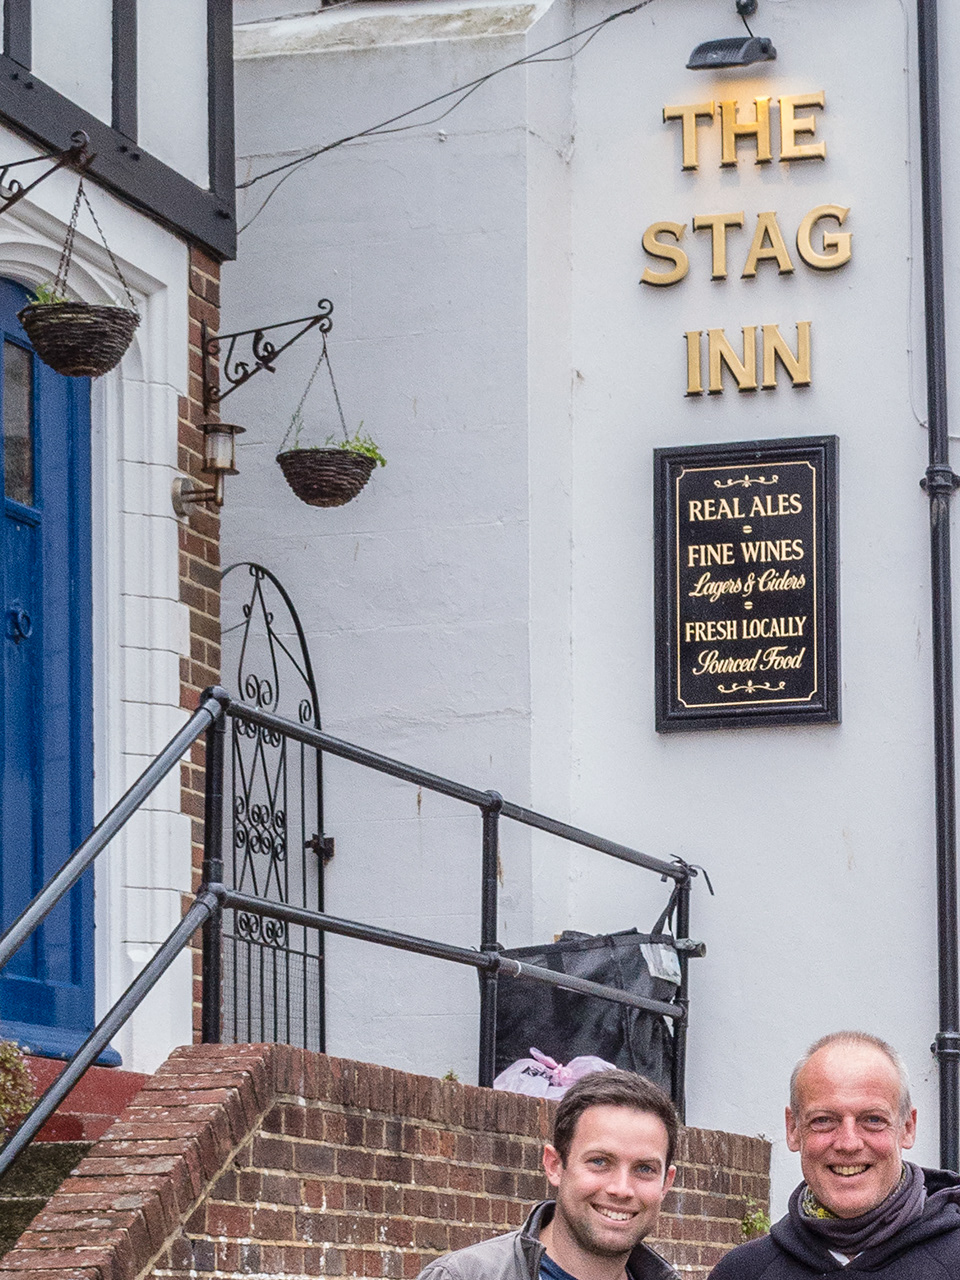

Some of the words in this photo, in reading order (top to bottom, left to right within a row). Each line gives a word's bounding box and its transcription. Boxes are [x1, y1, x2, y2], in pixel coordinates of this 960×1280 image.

[662, 90, 826, 171] THE
[639, 203, 853, 287] STAG
[683, 321, 812, 397] INN
[688, 496, 745, 522] REAL
[750, 493, 803, 517] ALES
[687, 543, 735, 567] FINE
[740, 539, 804, 563] WINES
[688, 572, 742, 602] Lagers
[742, 572, 755, 597] &
[757, 568, 806, 592] Ciders
[685, 619, 737, 642] FRESH
[742, 616, 807, 639] LOCALLY
[692, 649, 762, 676] Sourced
[759, 646, 806, 671] Food
